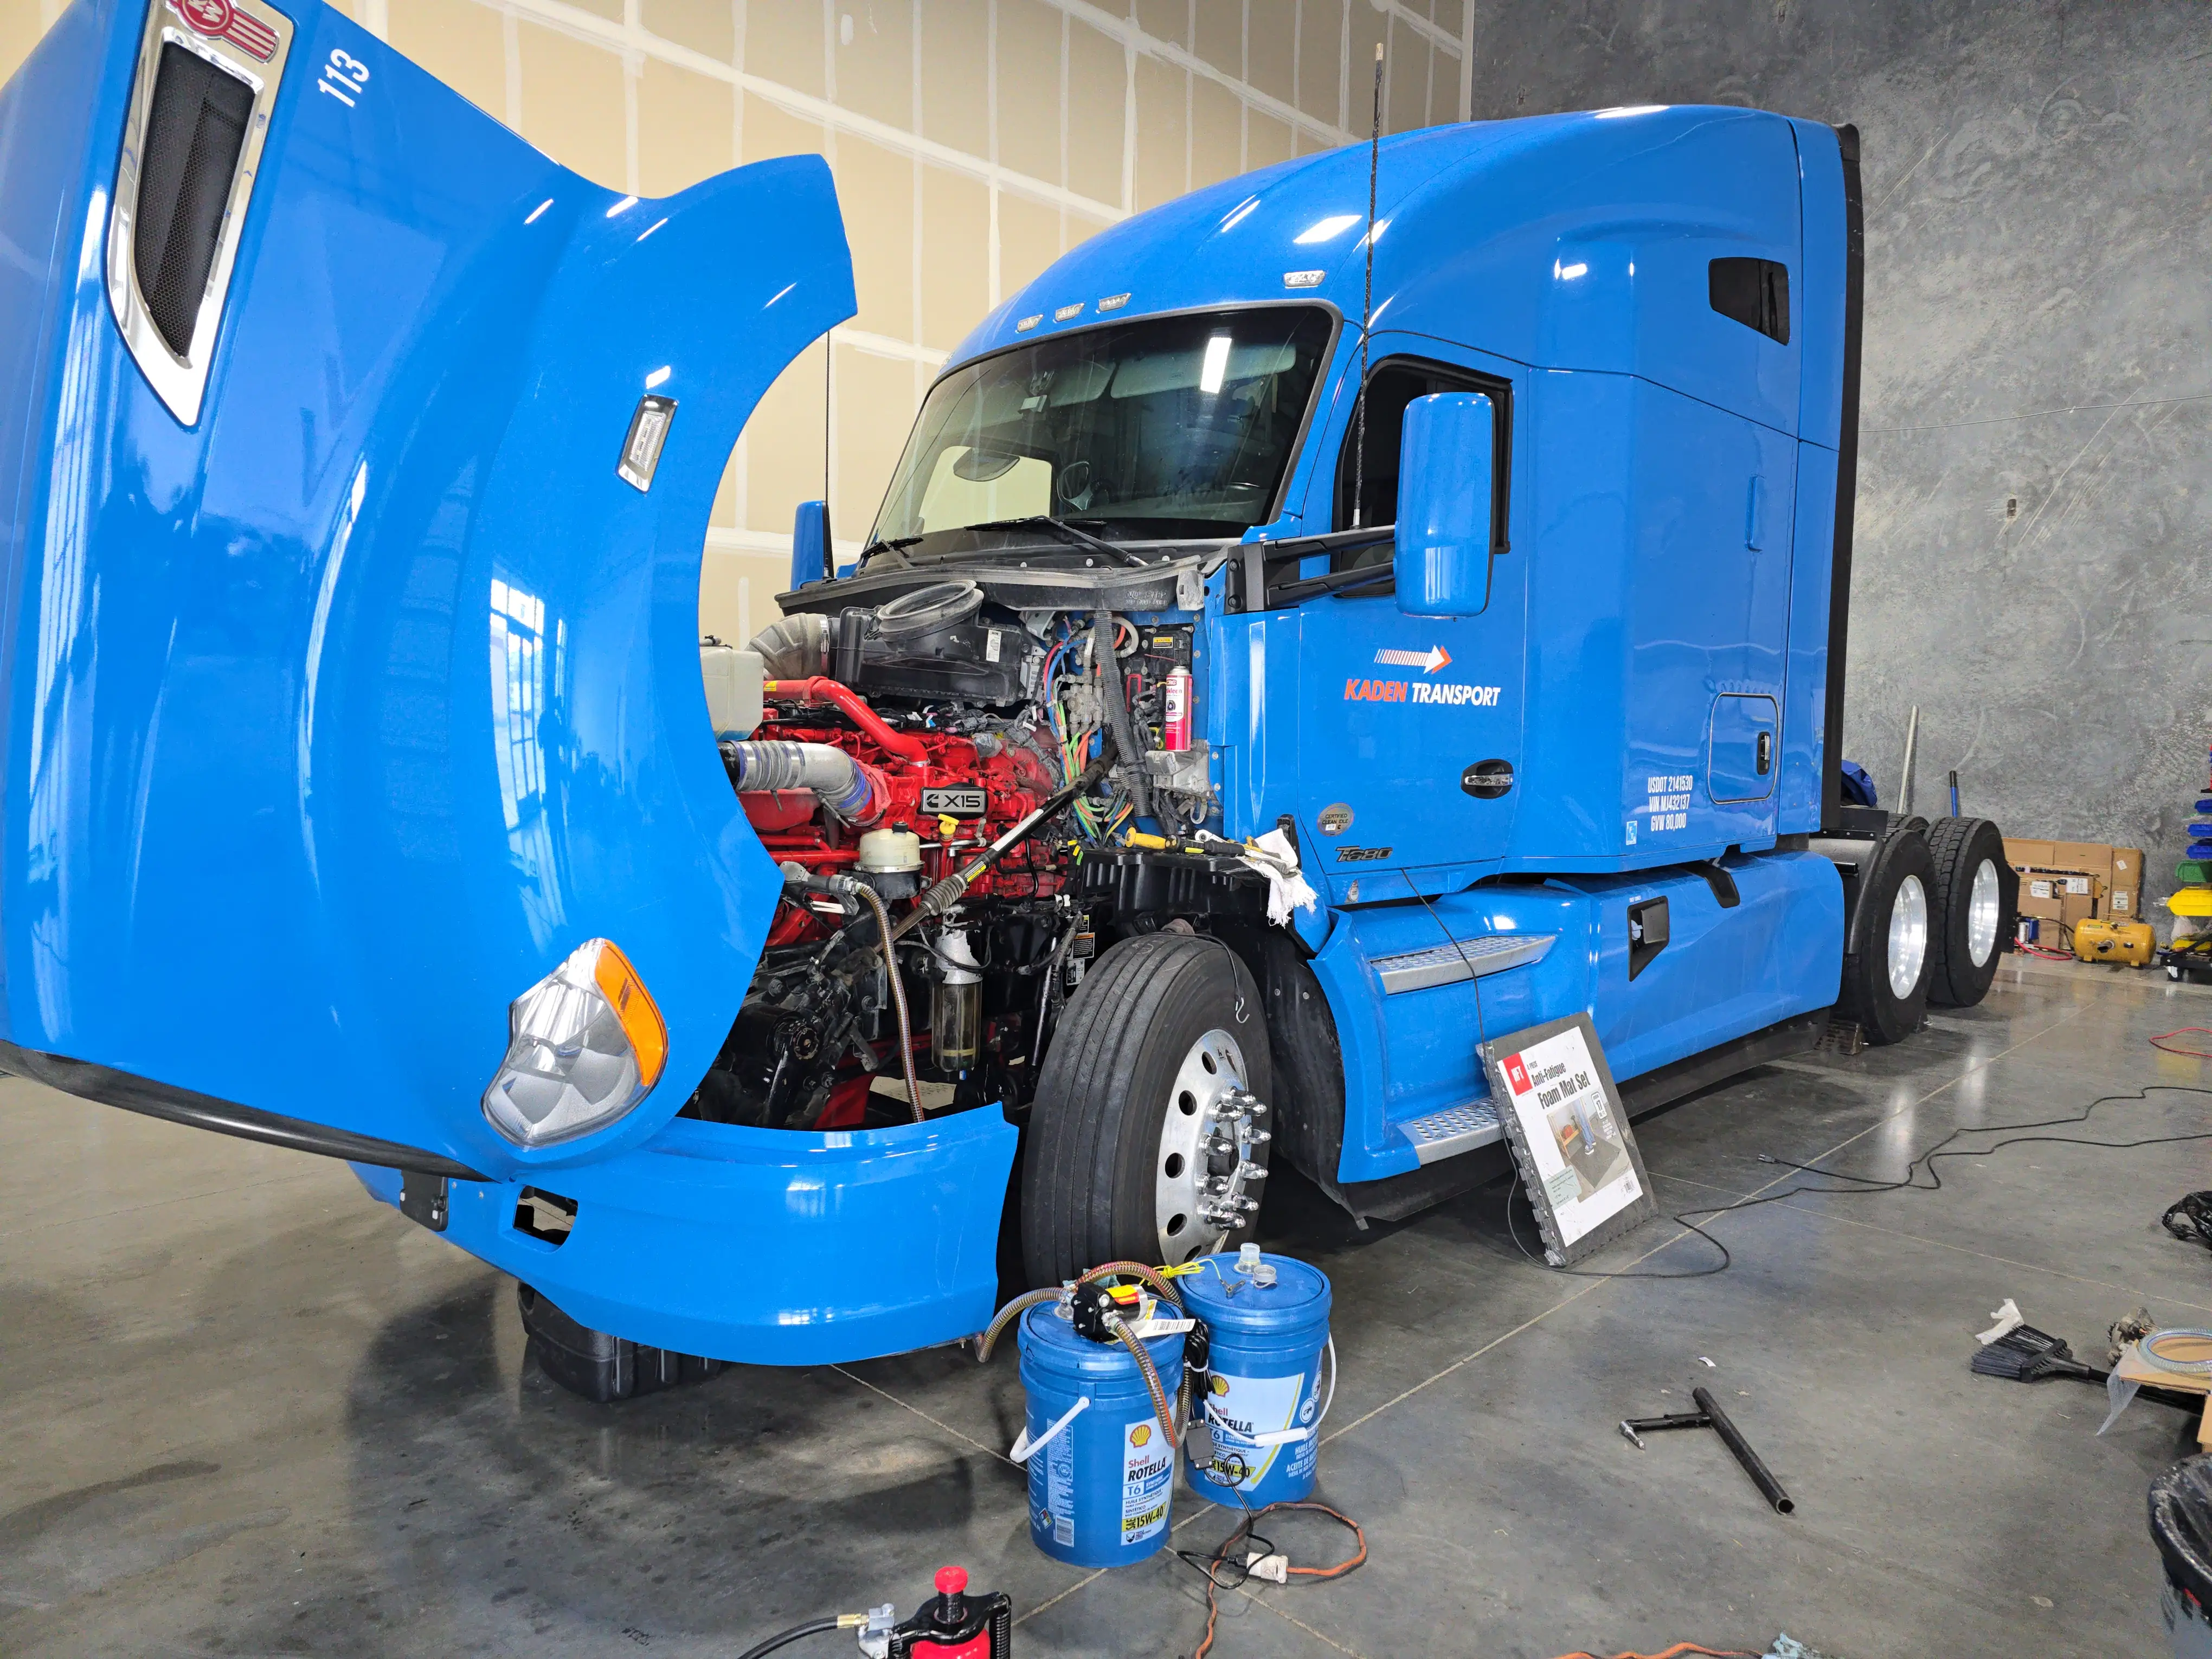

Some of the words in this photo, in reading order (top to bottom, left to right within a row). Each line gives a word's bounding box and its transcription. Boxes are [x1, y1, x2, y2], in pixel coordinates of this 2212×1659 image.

[317, 48, 369, 108] 113
[1344, 679, 1408, 702] KADEN
[1412, 682, 1501, 706] TRANSPORT
[1648, 776, 1668, 793] USDOT
[1668, 775, 1693, 792] 2141530
[943, 795, 981, 808] X15
[1649, 796, 1660, 813] VIN
[1661, 794, 1690, 812] MJ432137
[1651, 814, 1665, 832] GVW
[1666, 812, 1687, 832] 80,000
[1335, 846, 1393, 862] T680
[1510, 1065, 1525, 1082] HFT
[1531, 1062, 1566, 1088] Anti-Fatigue
[1537, 1086, 1562, 1110] Foam
[1559, 1077, 1578, 1099] Mat
[1574, 1071, 1591, 1090] Set
[1128, 1455, 1149, 1469] Shell
[1128, 1456, 1167, 1482] ROTELLA
[1217, 1459, 1250, 1478] 15W-40
[1128, 1484, 1141, 1496] T6
[1126, 1518, 1136, 1530] SAE
[1137, 1505, 1163, 1528] 15W-40
